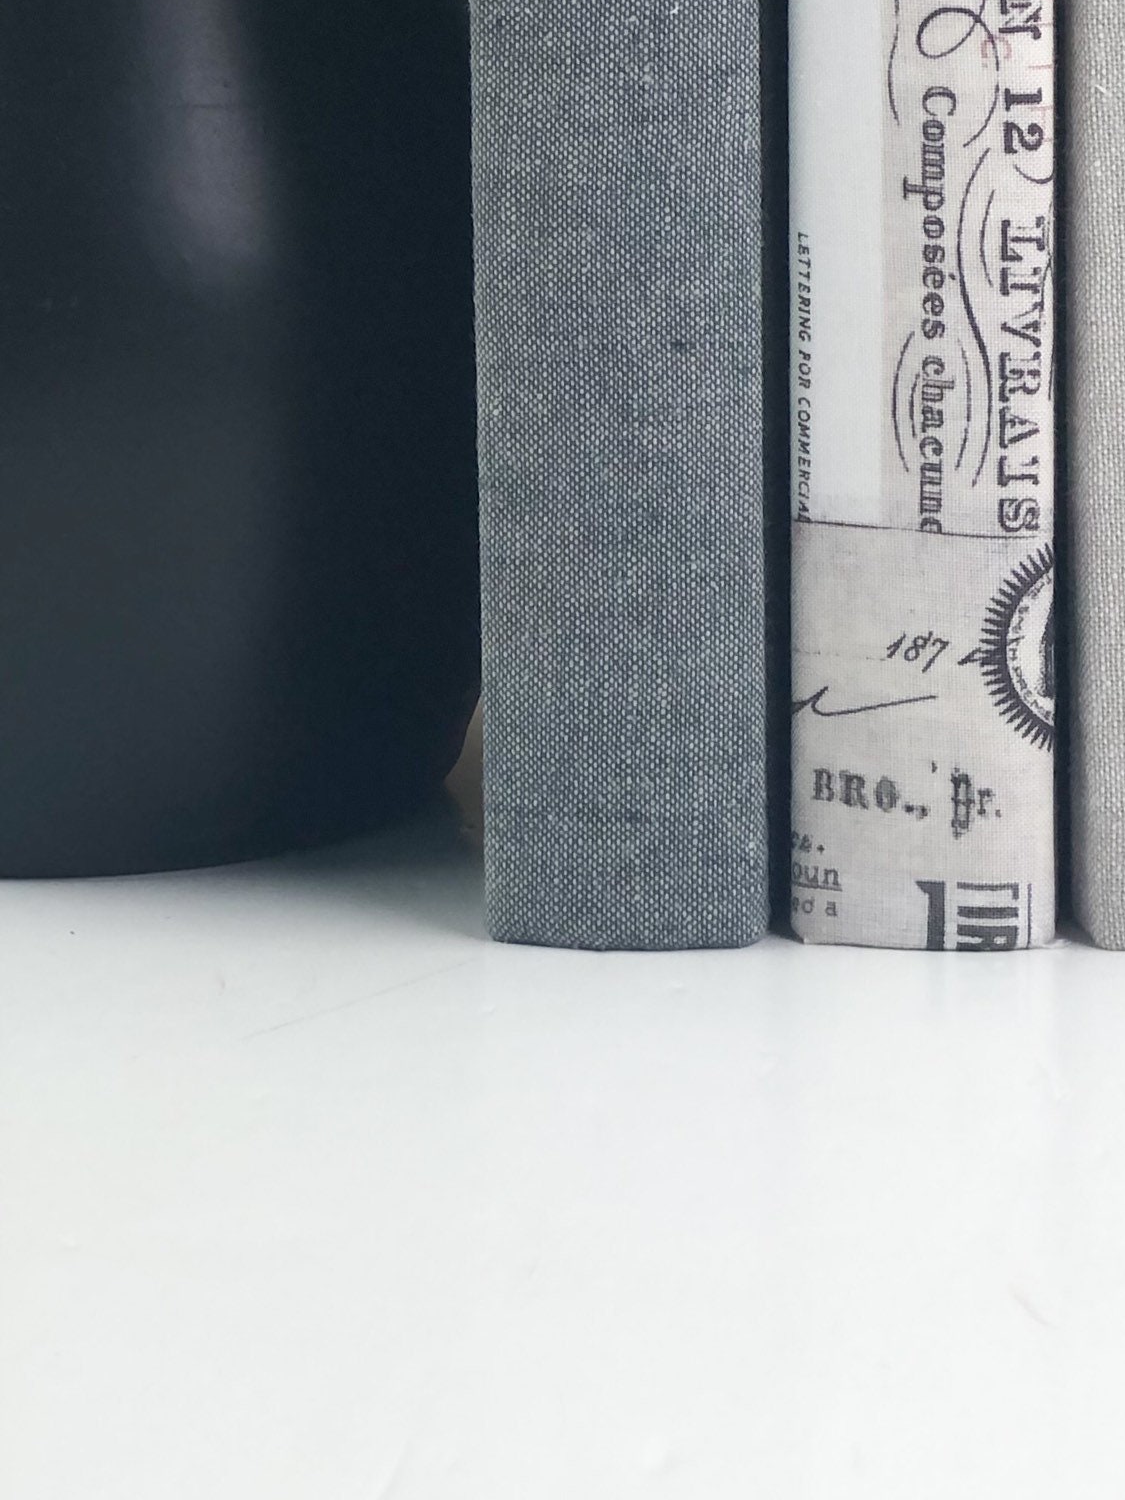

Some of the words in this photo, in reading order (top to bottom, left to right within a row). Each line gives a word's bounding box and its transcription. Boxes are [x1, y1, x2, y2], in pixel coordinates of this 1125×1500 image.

[1003, 87, 1044, 154] 12
[903, 86, 957, 340] Composées
[797, 232, 812, 344] LETTERING
[797, 348, 812, 389] FOR
[997, 216, 1046, 533] LIVRAIS
[885, 630, 951, 674] 187
